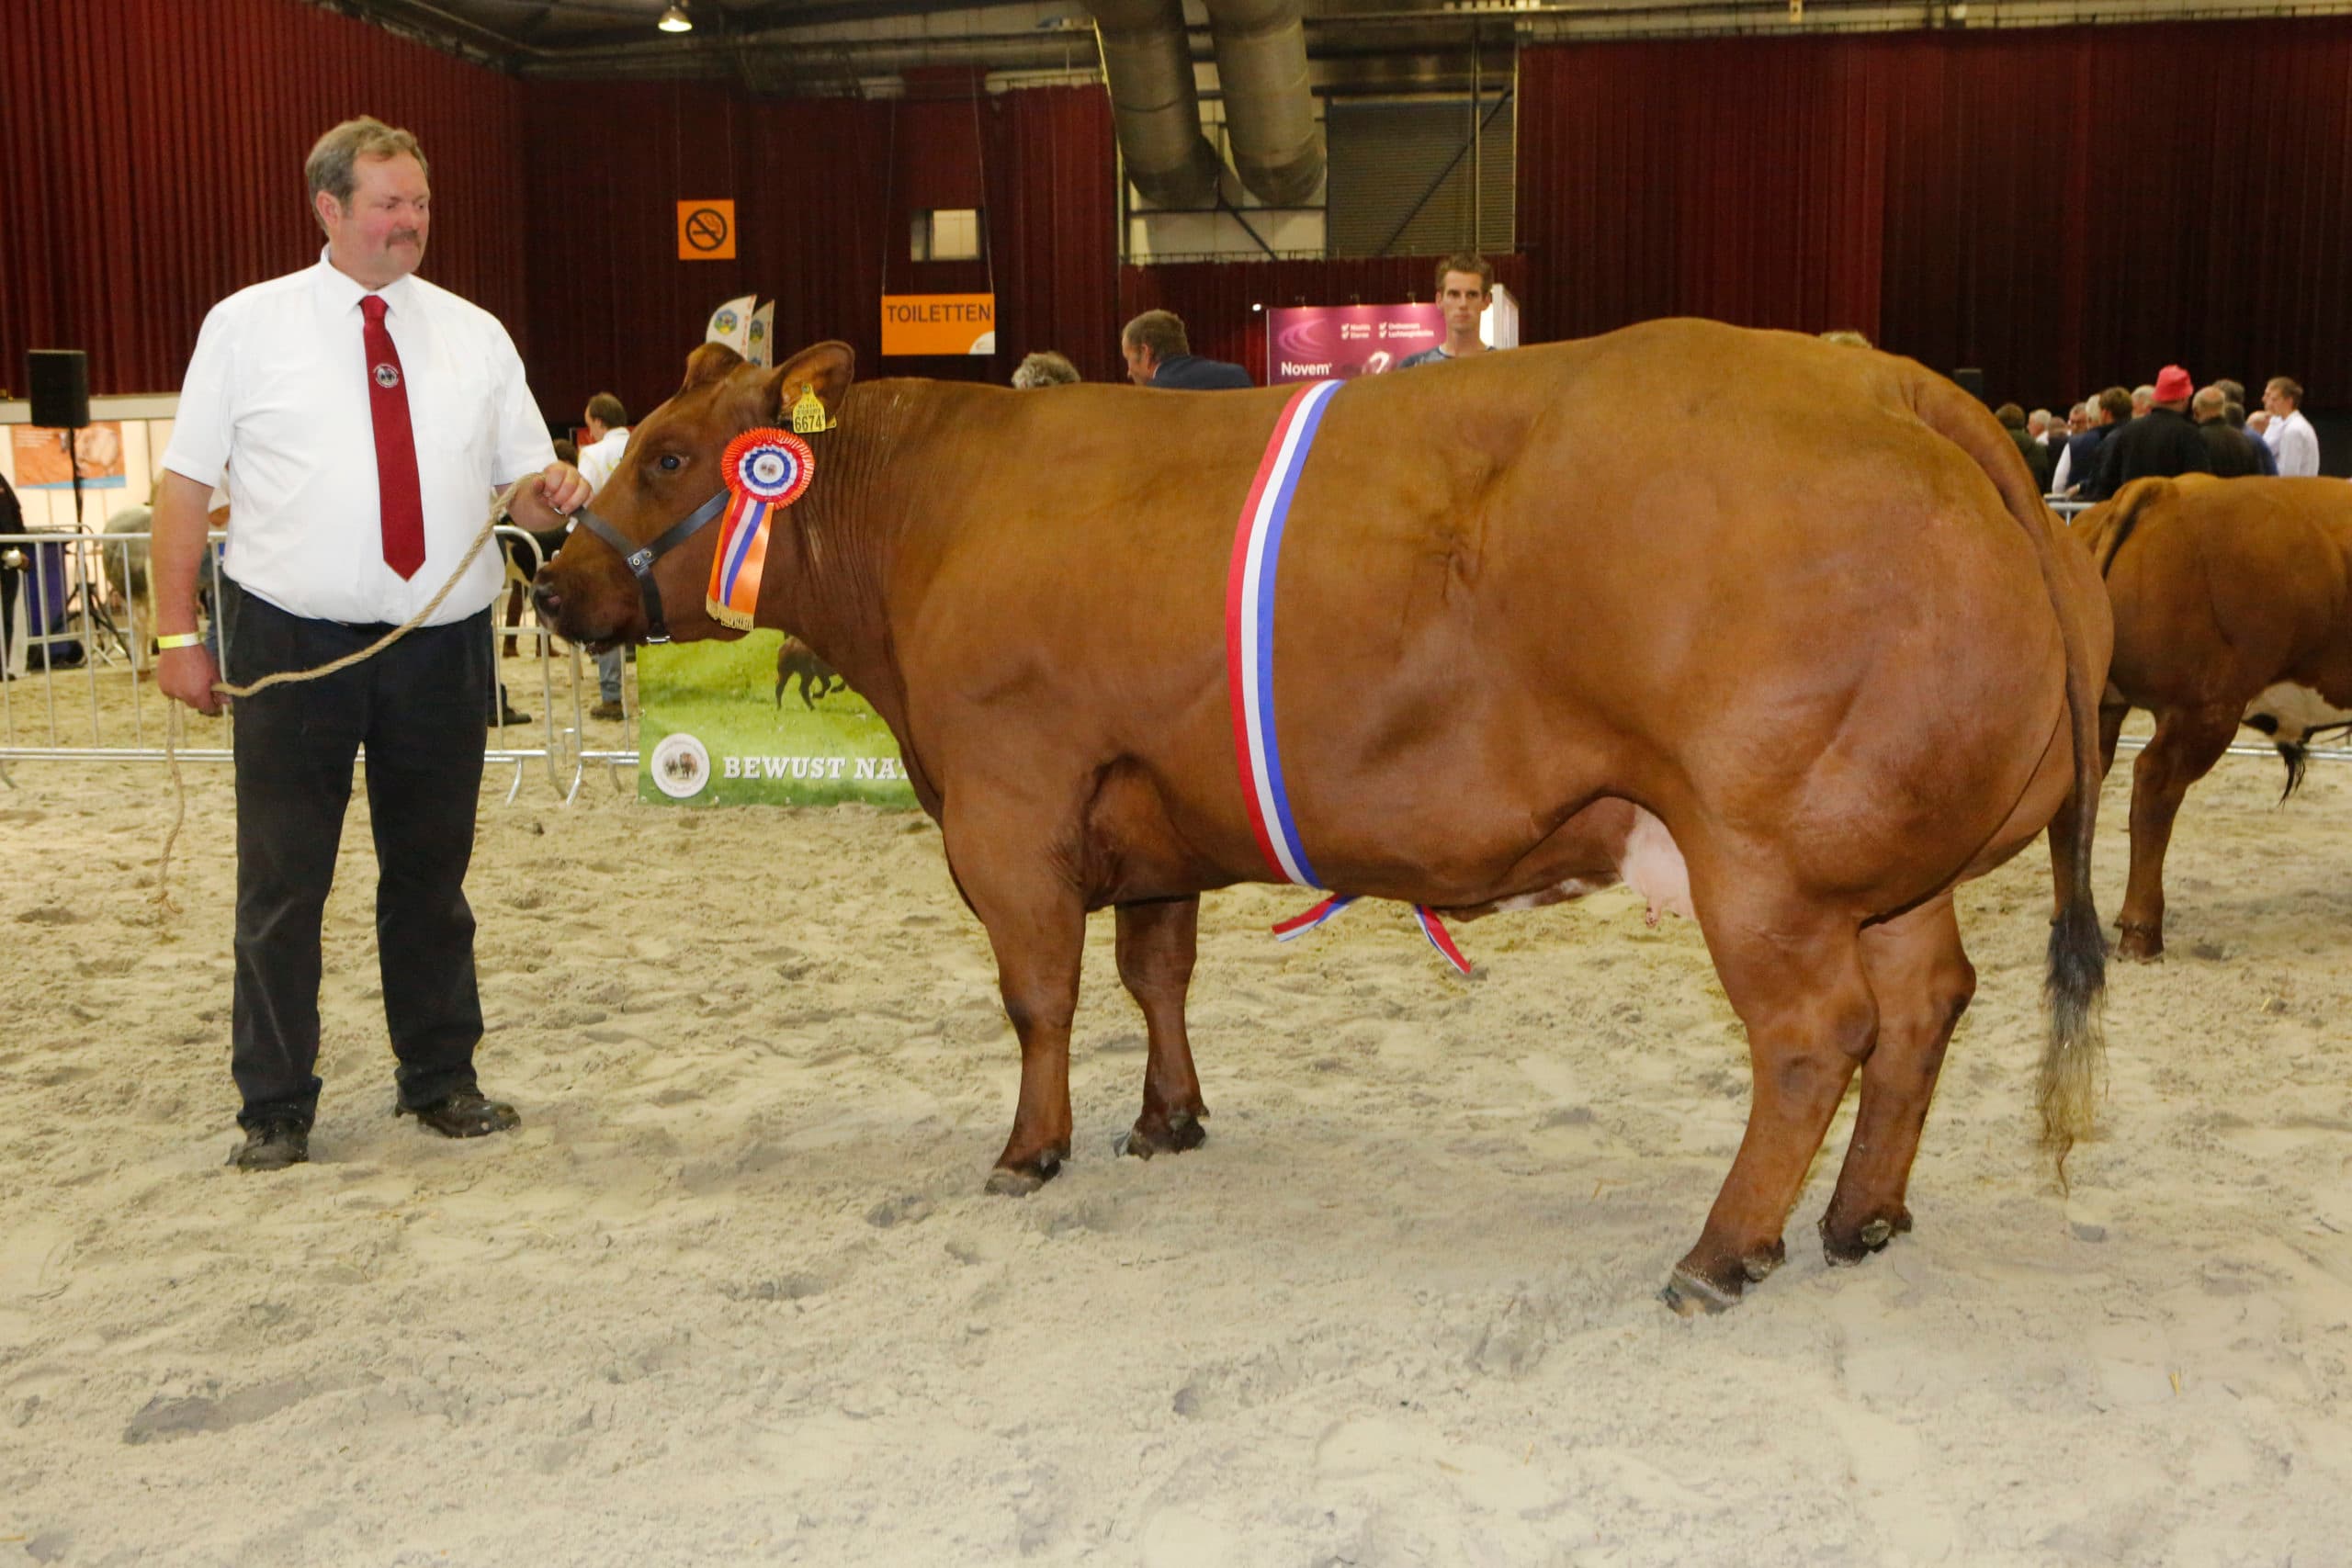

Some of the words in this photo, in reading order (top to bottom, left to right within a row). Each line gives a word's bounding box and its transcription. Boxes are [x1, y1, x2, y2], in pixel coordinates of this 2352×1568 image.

[887, 303, 991, 323] TOILETTEN
[1281, 361, 1329, 376] Novem
[794, 415, 823, 433] 6674
[722, 757, 847, 780] BEWUST
